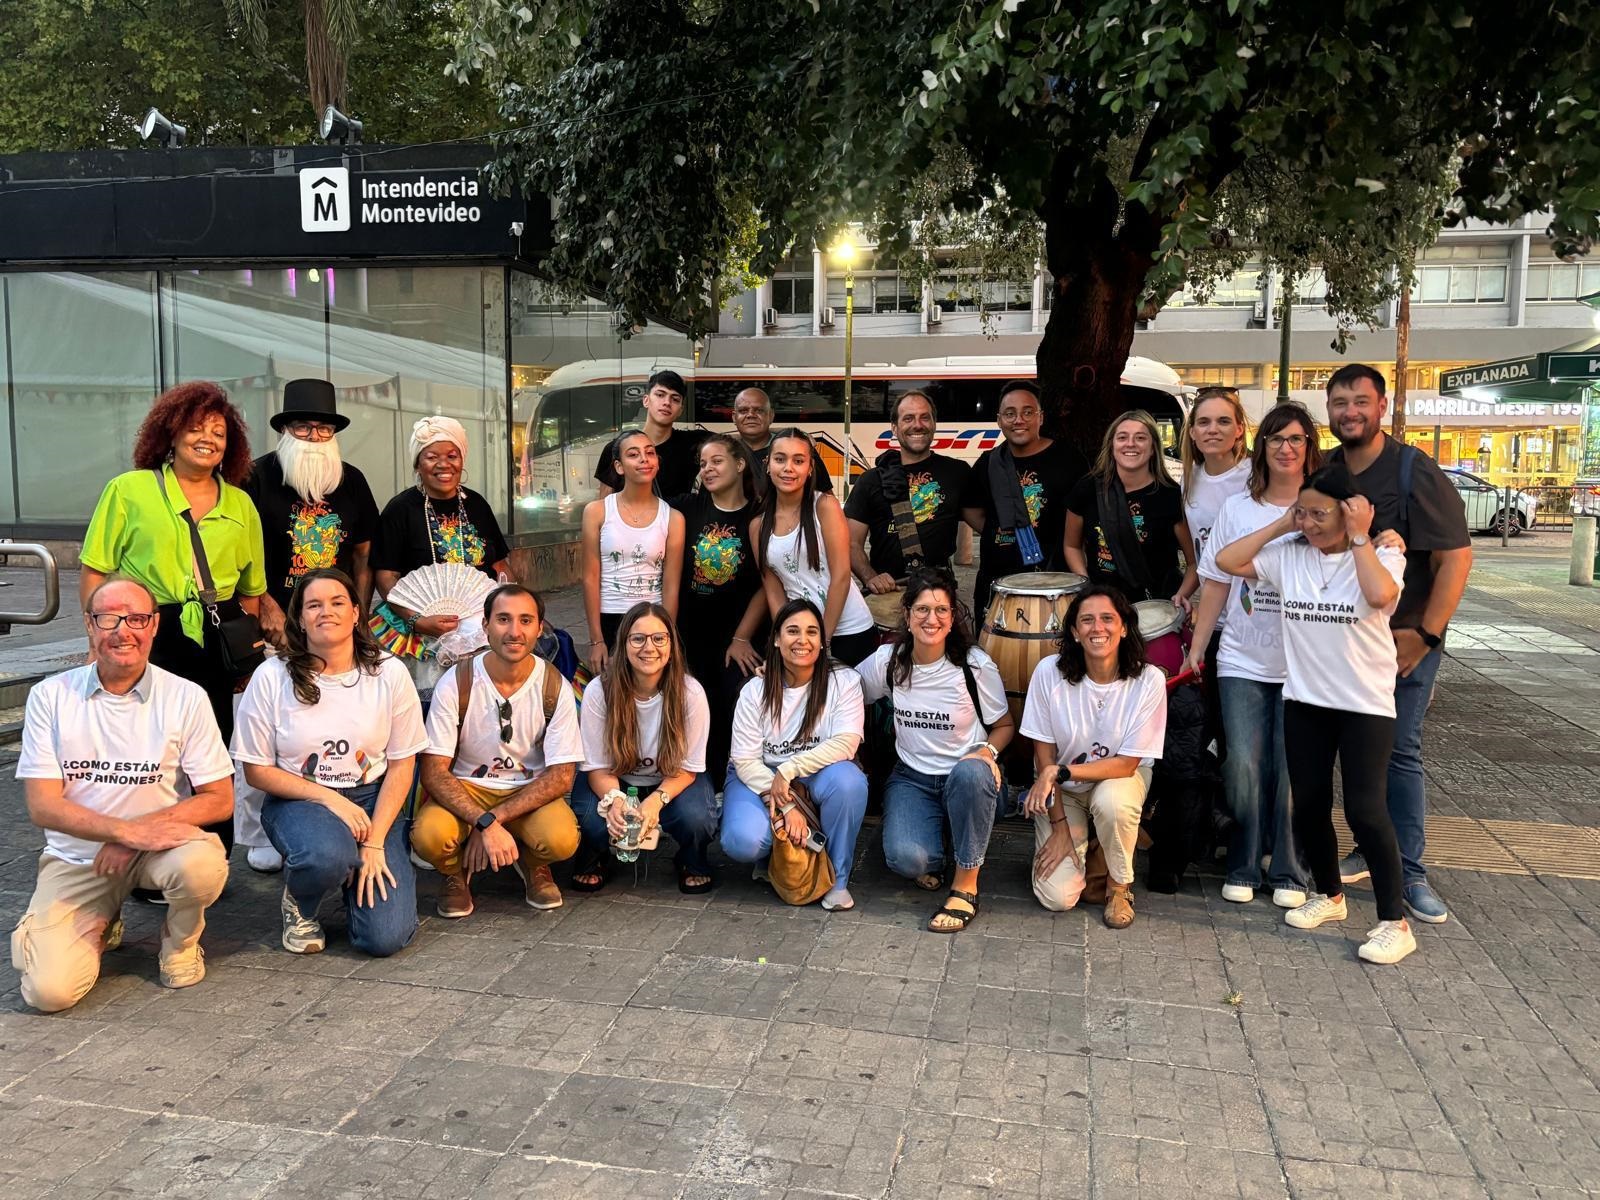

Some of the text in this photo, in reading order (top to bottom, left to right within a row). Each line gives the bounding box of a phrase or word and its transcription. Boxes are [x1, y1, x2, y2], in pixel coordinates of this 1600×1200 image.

[362, 176, 479, 199] Intendencia
[362, 201, 481, 223] Montevideo
[1447, 363, 1529, 388] EXPLANADA
[1414, 399, 1491, 416] PARRILLA
[1494, 403, 1545, 416] DESDE
[291, 554, 305, 567] 10
[1317, 602, 1355, 613] ESTÁN
[1284, 611, 1359, 625] TUS RIÑONES?
[914, 710, 950, 722] ESTÁN
[903, 719, 956, 731] RIÑONES?
[323, 739, 350, 760] 20
[1092, 741, 1109, 758] 20
[63, 760, 160, 773] ¿COMO ESTÁN
[492, 756, 514, 772] 20
[67, 772, 163, 785] TUS RIÑONES?
